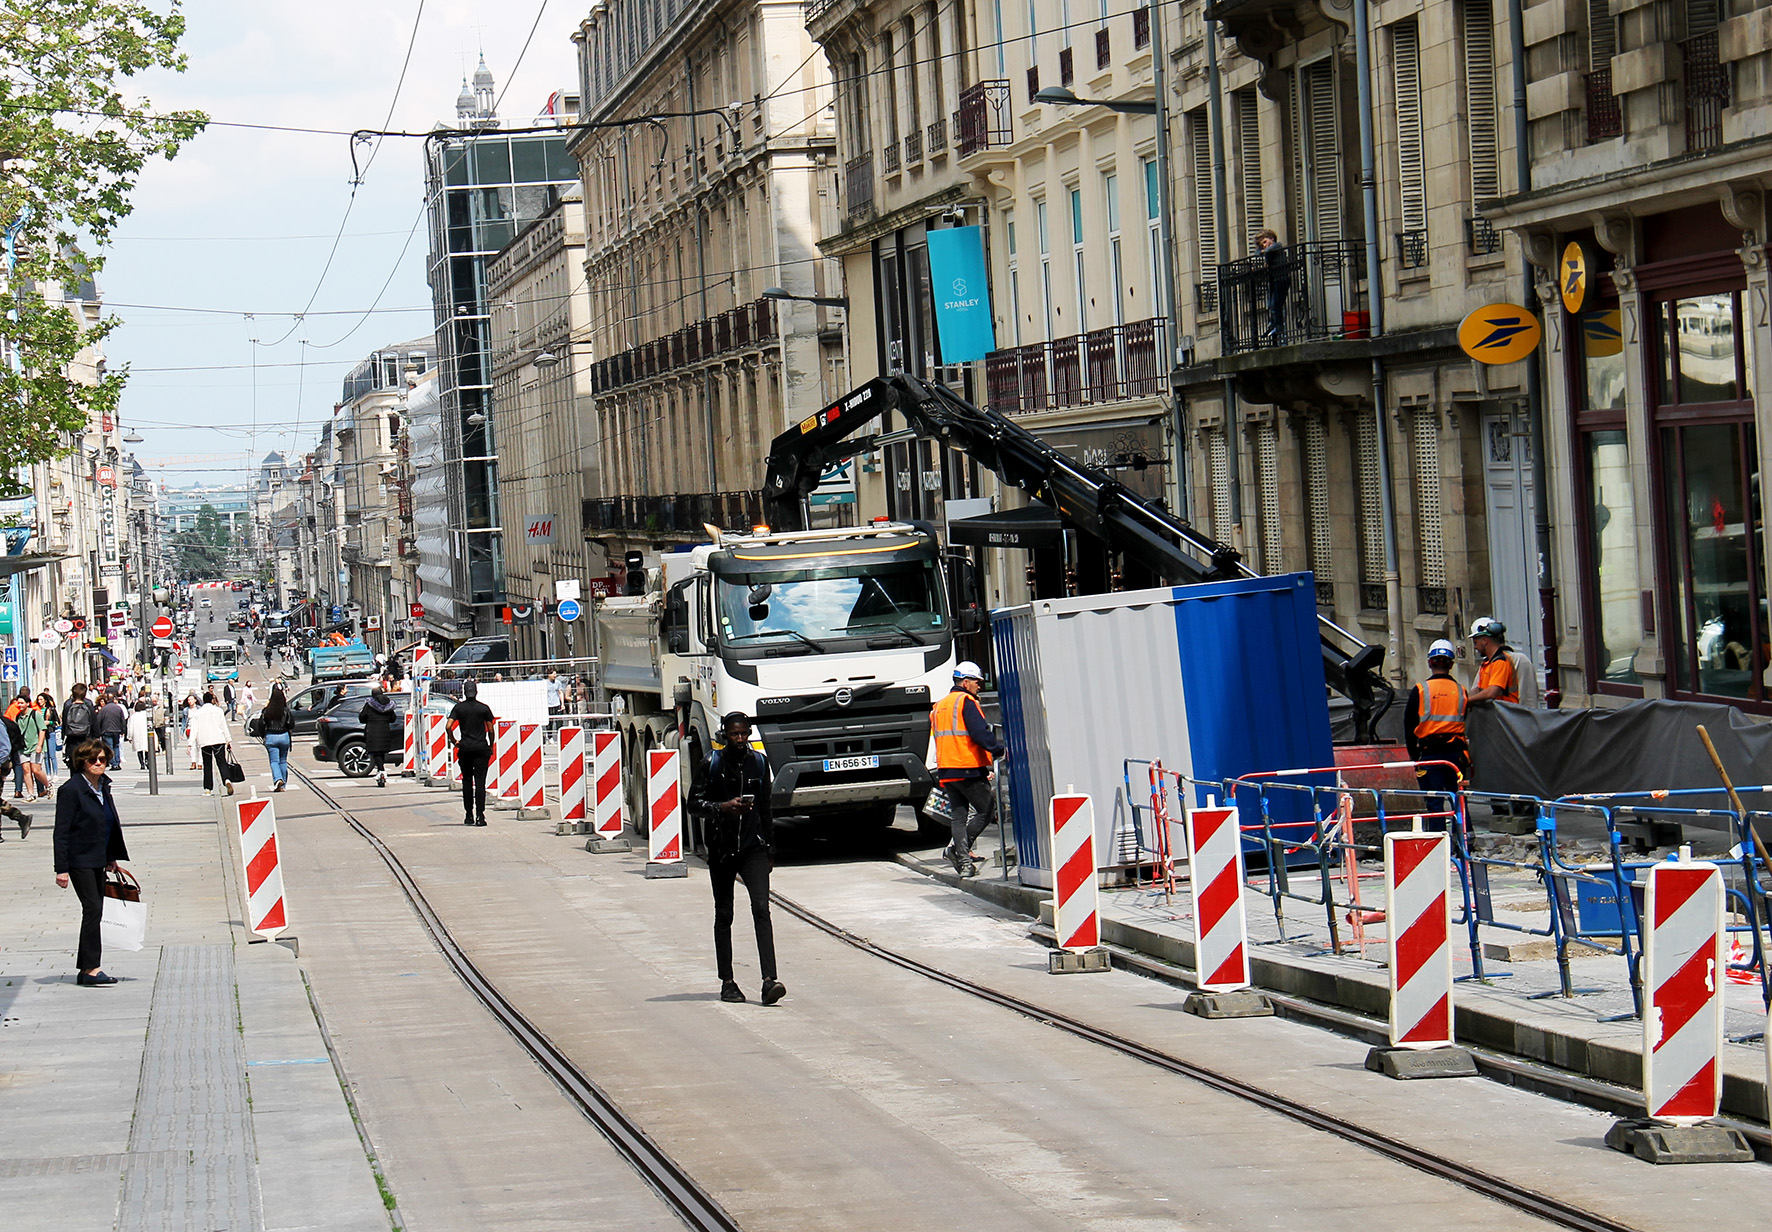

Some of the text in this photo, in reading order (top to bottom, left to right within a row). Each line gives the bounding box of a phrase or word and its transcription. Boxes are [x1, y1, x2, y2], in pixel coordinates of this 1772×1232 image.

[944, 298, 979, 310] STANLEY
[100, 470, 112, 480] AU
[102, 486, 115, 560] CACHET
